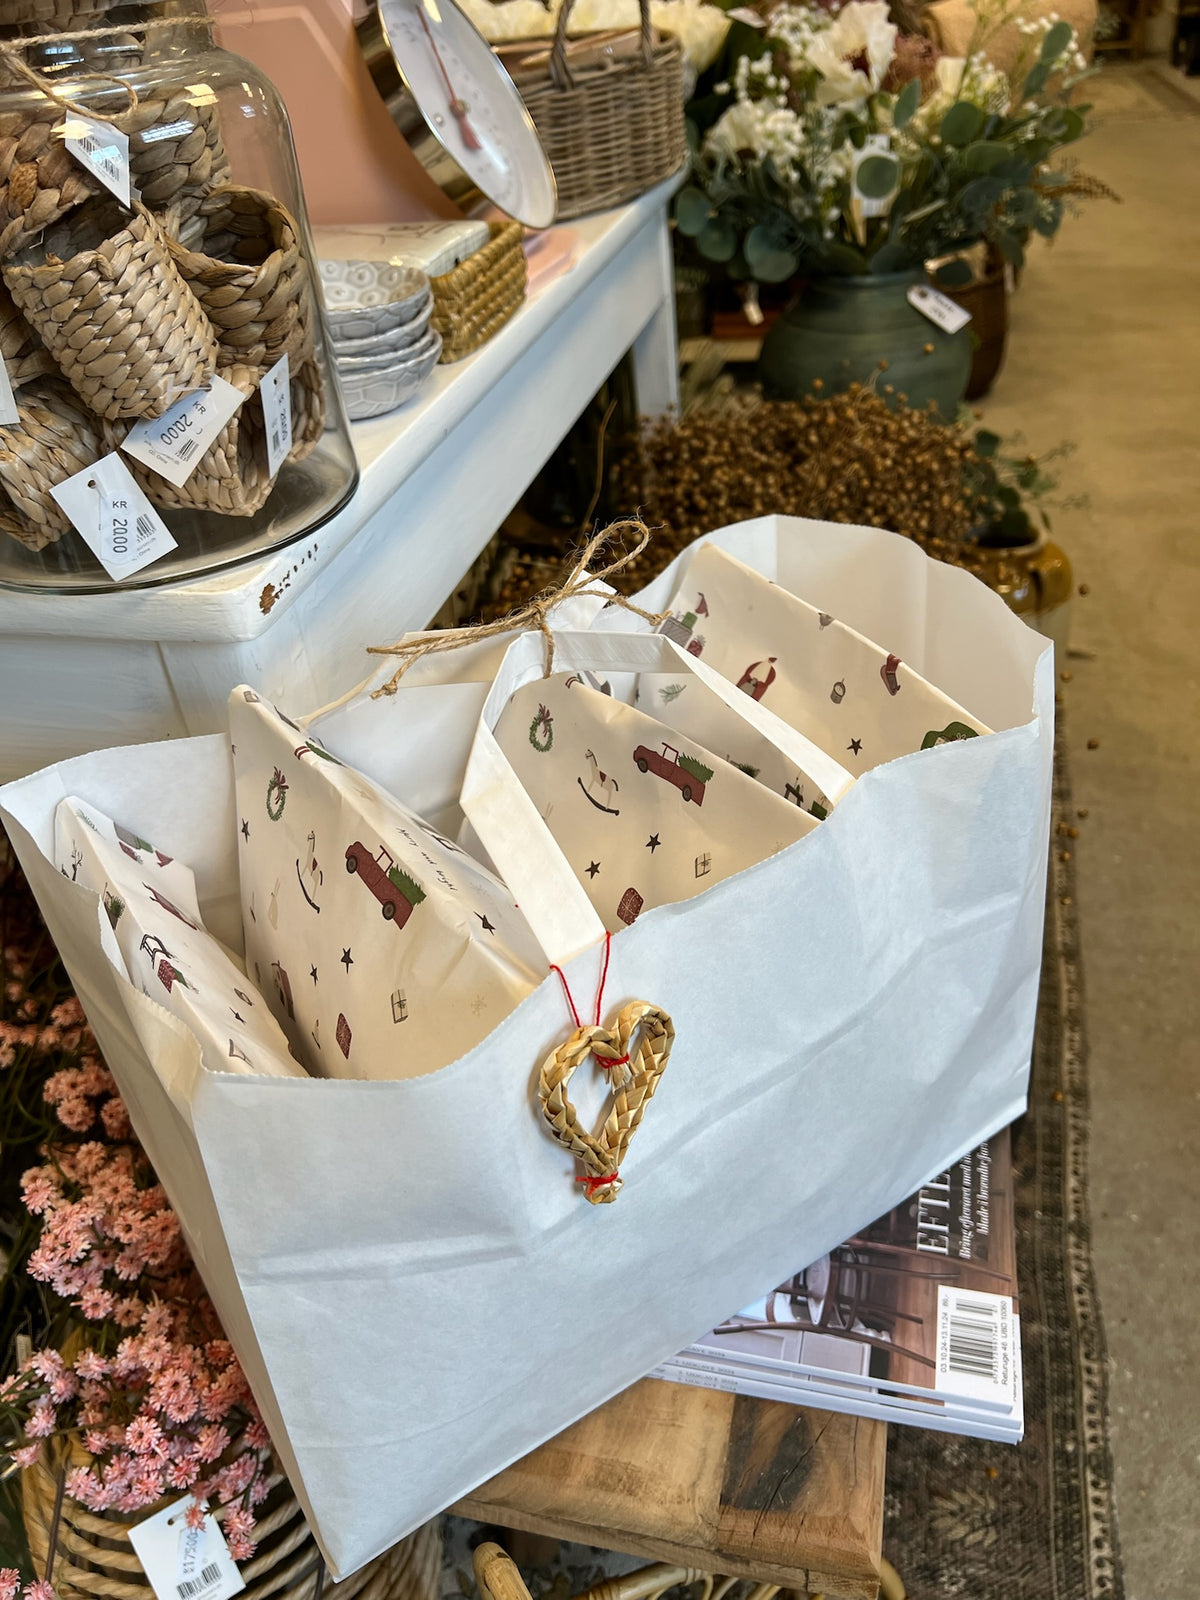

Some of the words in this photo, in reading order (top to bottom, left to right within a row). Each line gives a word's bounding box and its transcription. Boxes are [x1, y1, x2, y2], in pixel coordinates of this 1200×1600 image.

[193, 401, 207, 415] KR
[160, 413, 193, 446] 20.00
[112, 500, 128, 509] KR
[112, 518, 128, 554] 20.00
[396, 828, 419, 847] Merry
[421, 851, 437, 865] and
[436, 870, 458, 891] bright
[917, 1168, 951, 1255] EFTE
[959, 1231, 974, 1259] Bring
